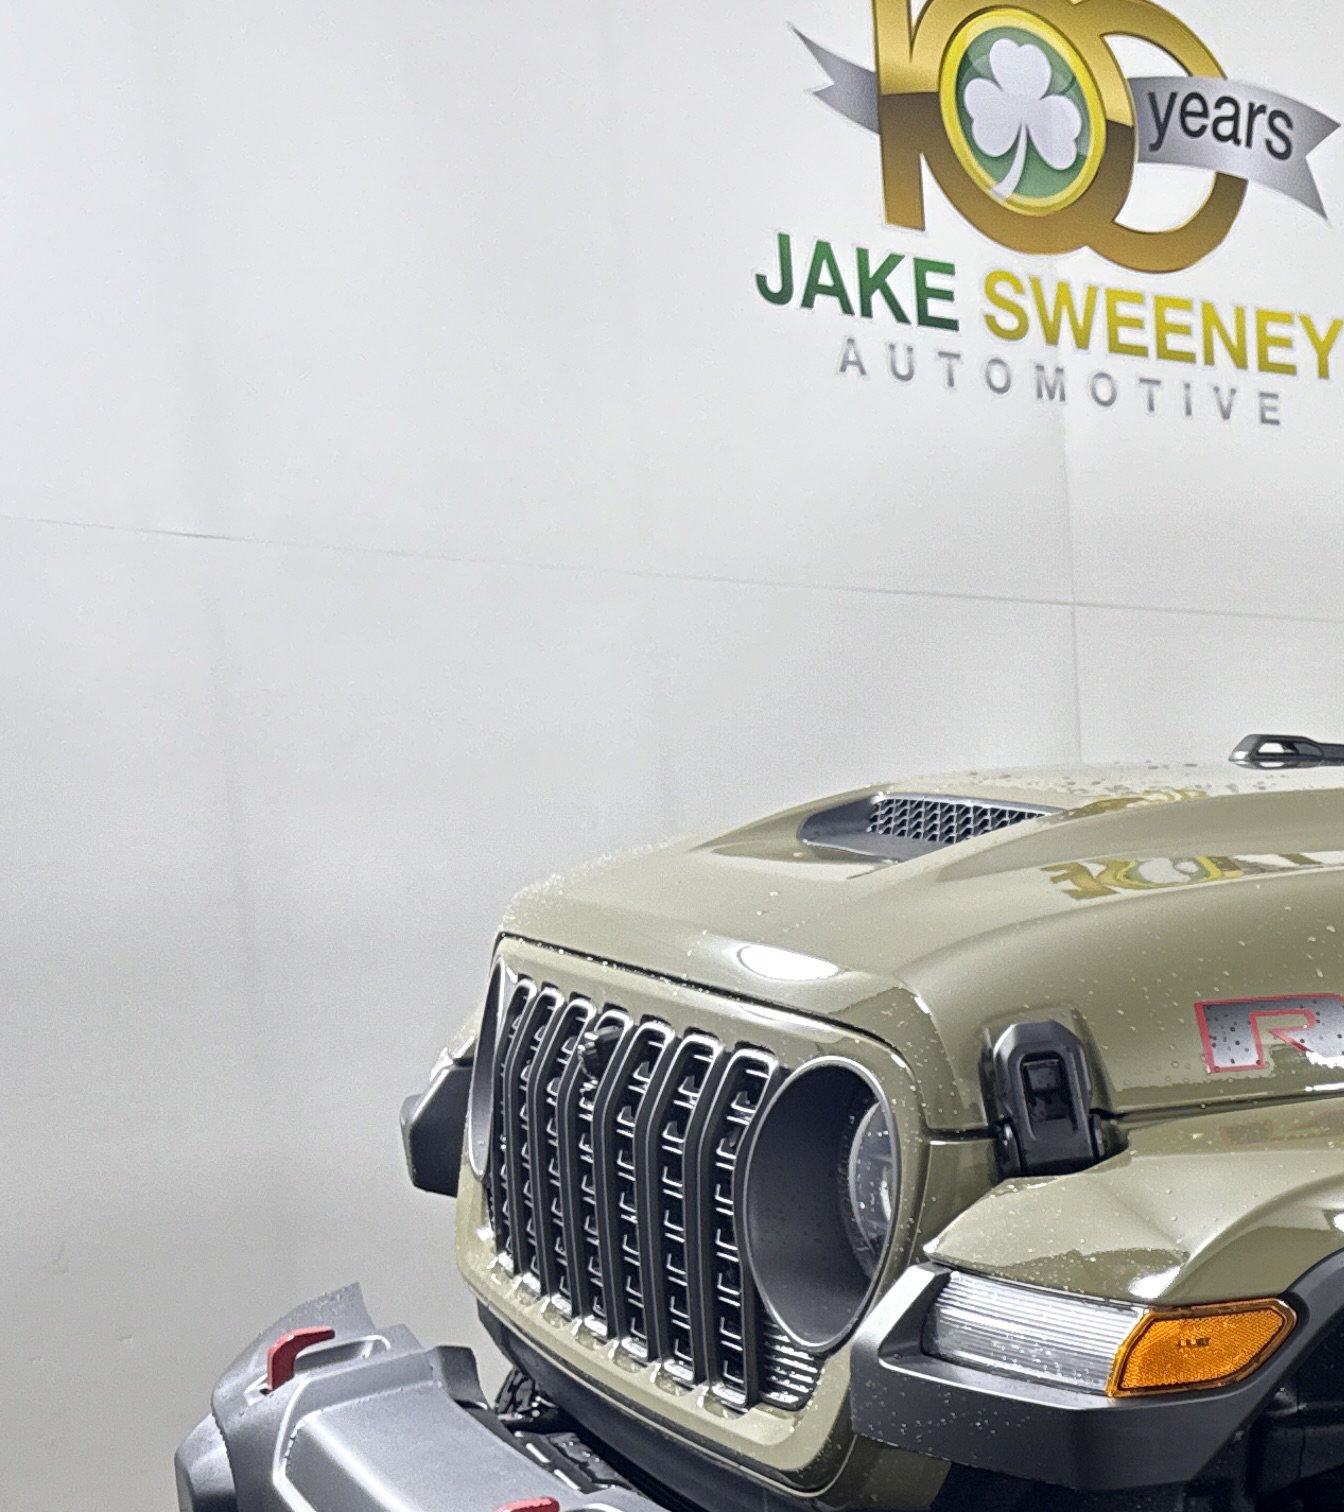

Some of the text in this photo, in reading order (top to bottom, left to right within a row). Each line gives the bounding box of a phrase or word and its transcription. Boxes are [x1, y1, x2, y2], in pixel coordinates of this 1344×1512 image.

[1147, 88, 1294, 161] years
[755, 232, 1344, 380] JAKE SWEENEY
[838, 338, 1281, 426] AUTOMOTIVE
